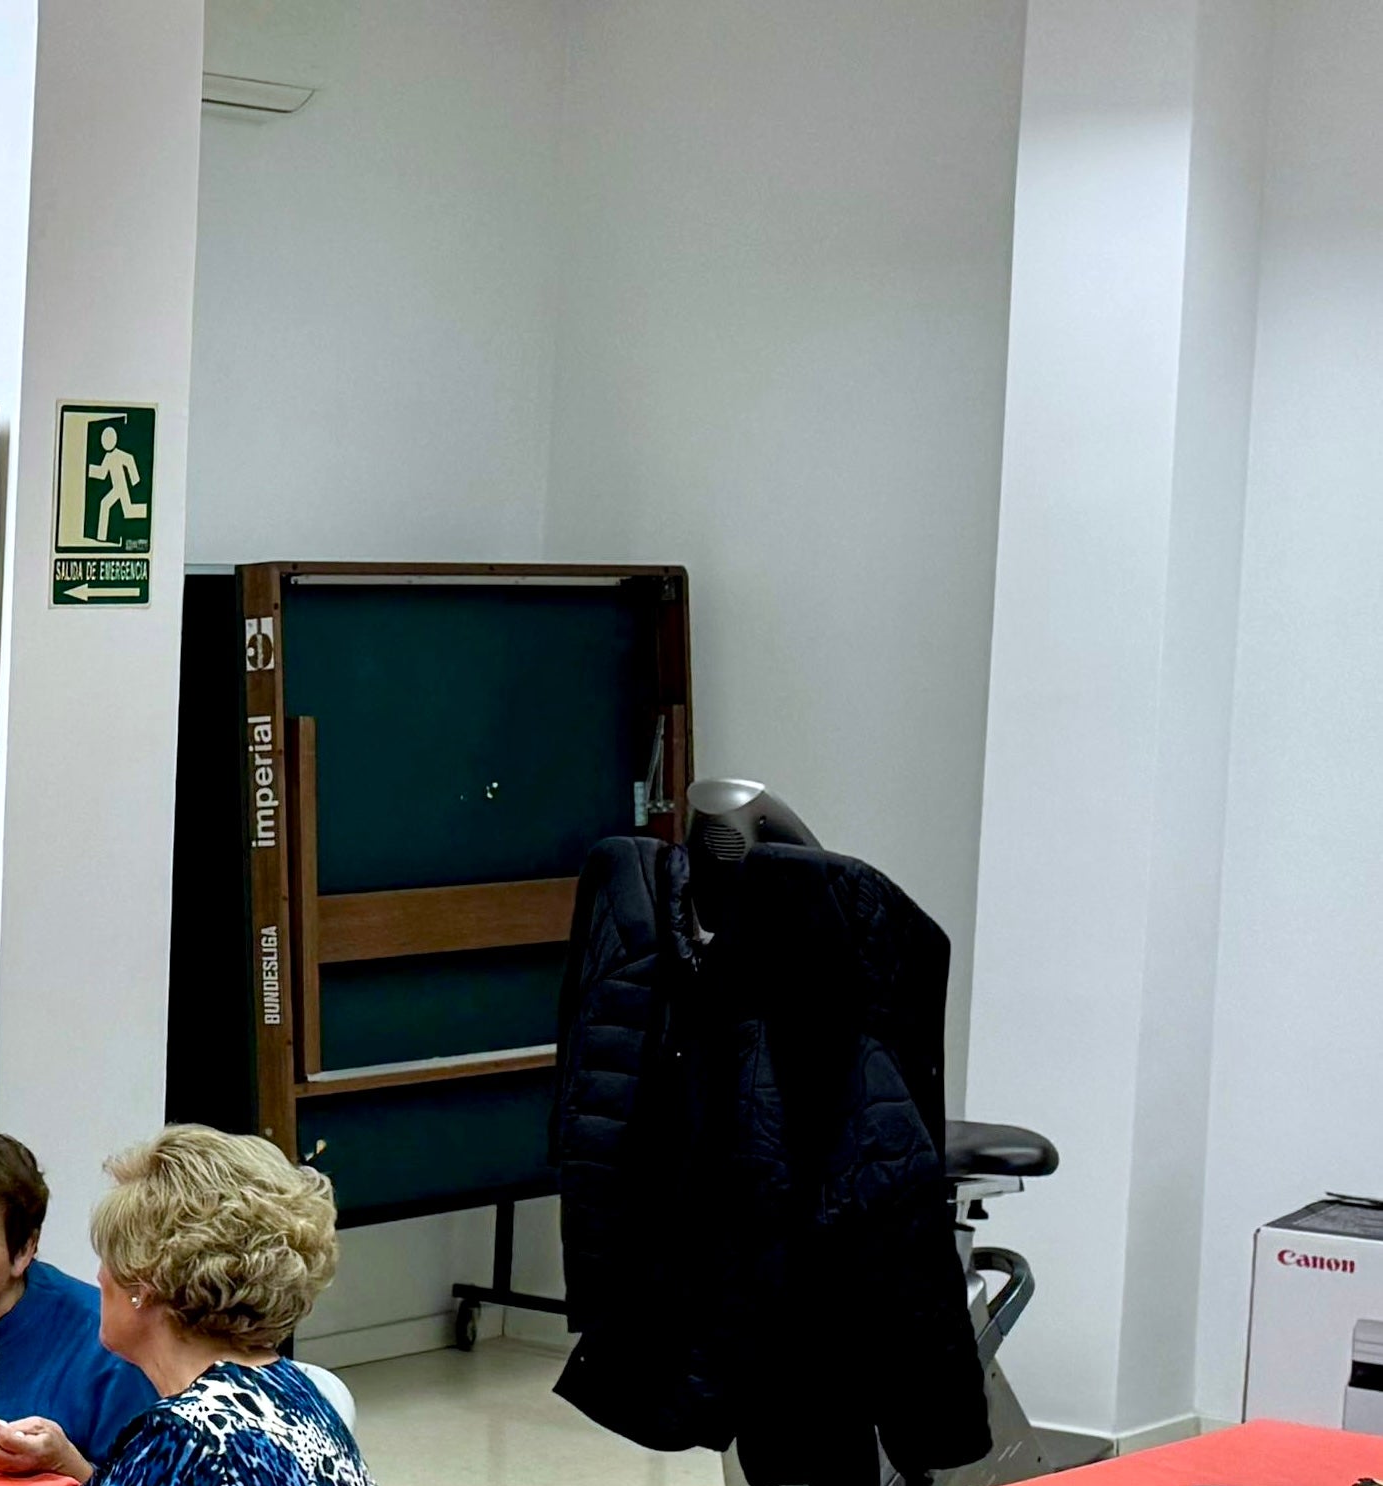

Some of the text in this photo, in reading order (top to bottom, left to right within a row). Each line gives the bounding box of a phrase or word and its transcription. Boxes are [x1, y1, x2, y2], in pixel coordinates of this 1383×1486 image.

[56, 561, 148, 581] SALIDA DE EMERGENCIA
[247, 715, 280, 848] imperial
[260, 925, 281, 1025] BUNDESLIGA
[1277, 1249, 1356, 1275] Canon
